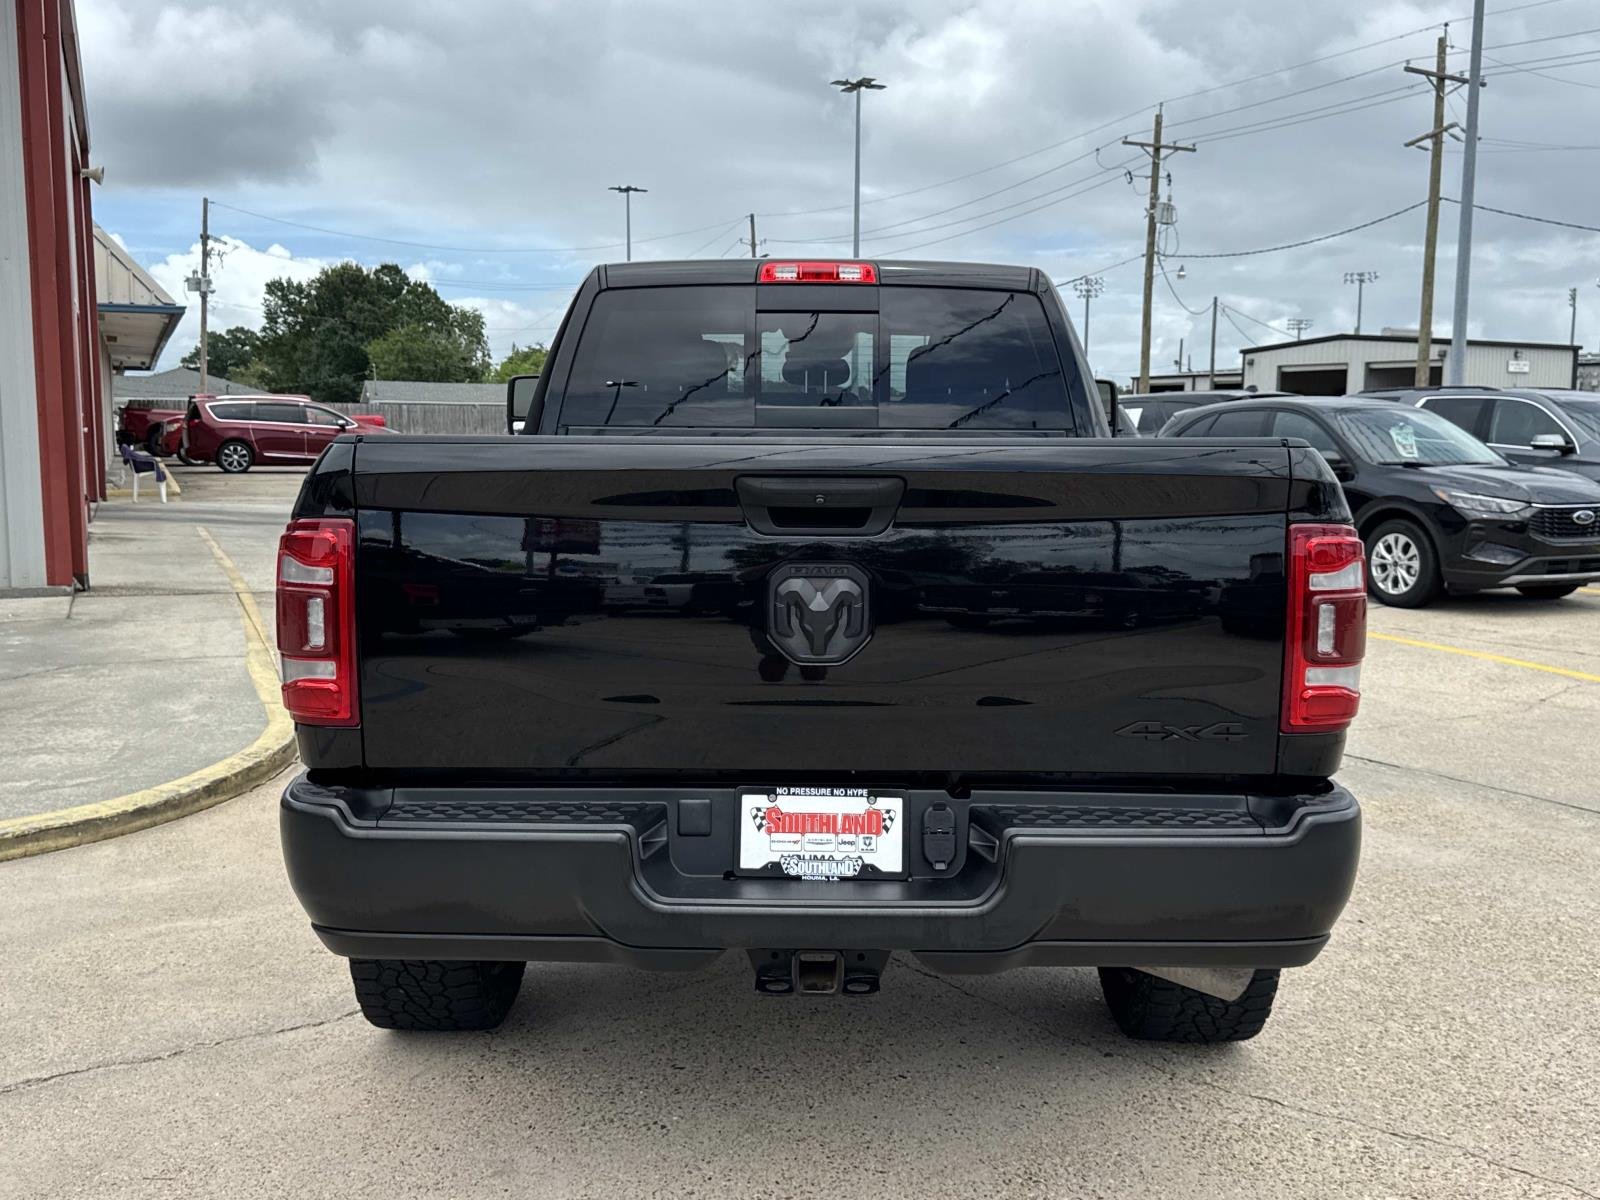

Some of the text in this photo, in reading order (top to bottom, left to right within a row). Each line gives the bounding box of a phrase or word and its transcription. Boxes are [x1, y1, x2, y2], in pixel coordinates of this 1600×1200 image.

[790, 567, 849, 576] RAM
[776, 787, 869, 797] NO PRESSURE NO HYPE
[765, 807, 883, 836] SOUTHLAND
[838, 838, 856, 847] Jeep
[789, 858, 854, 876] SOUTHLAND
